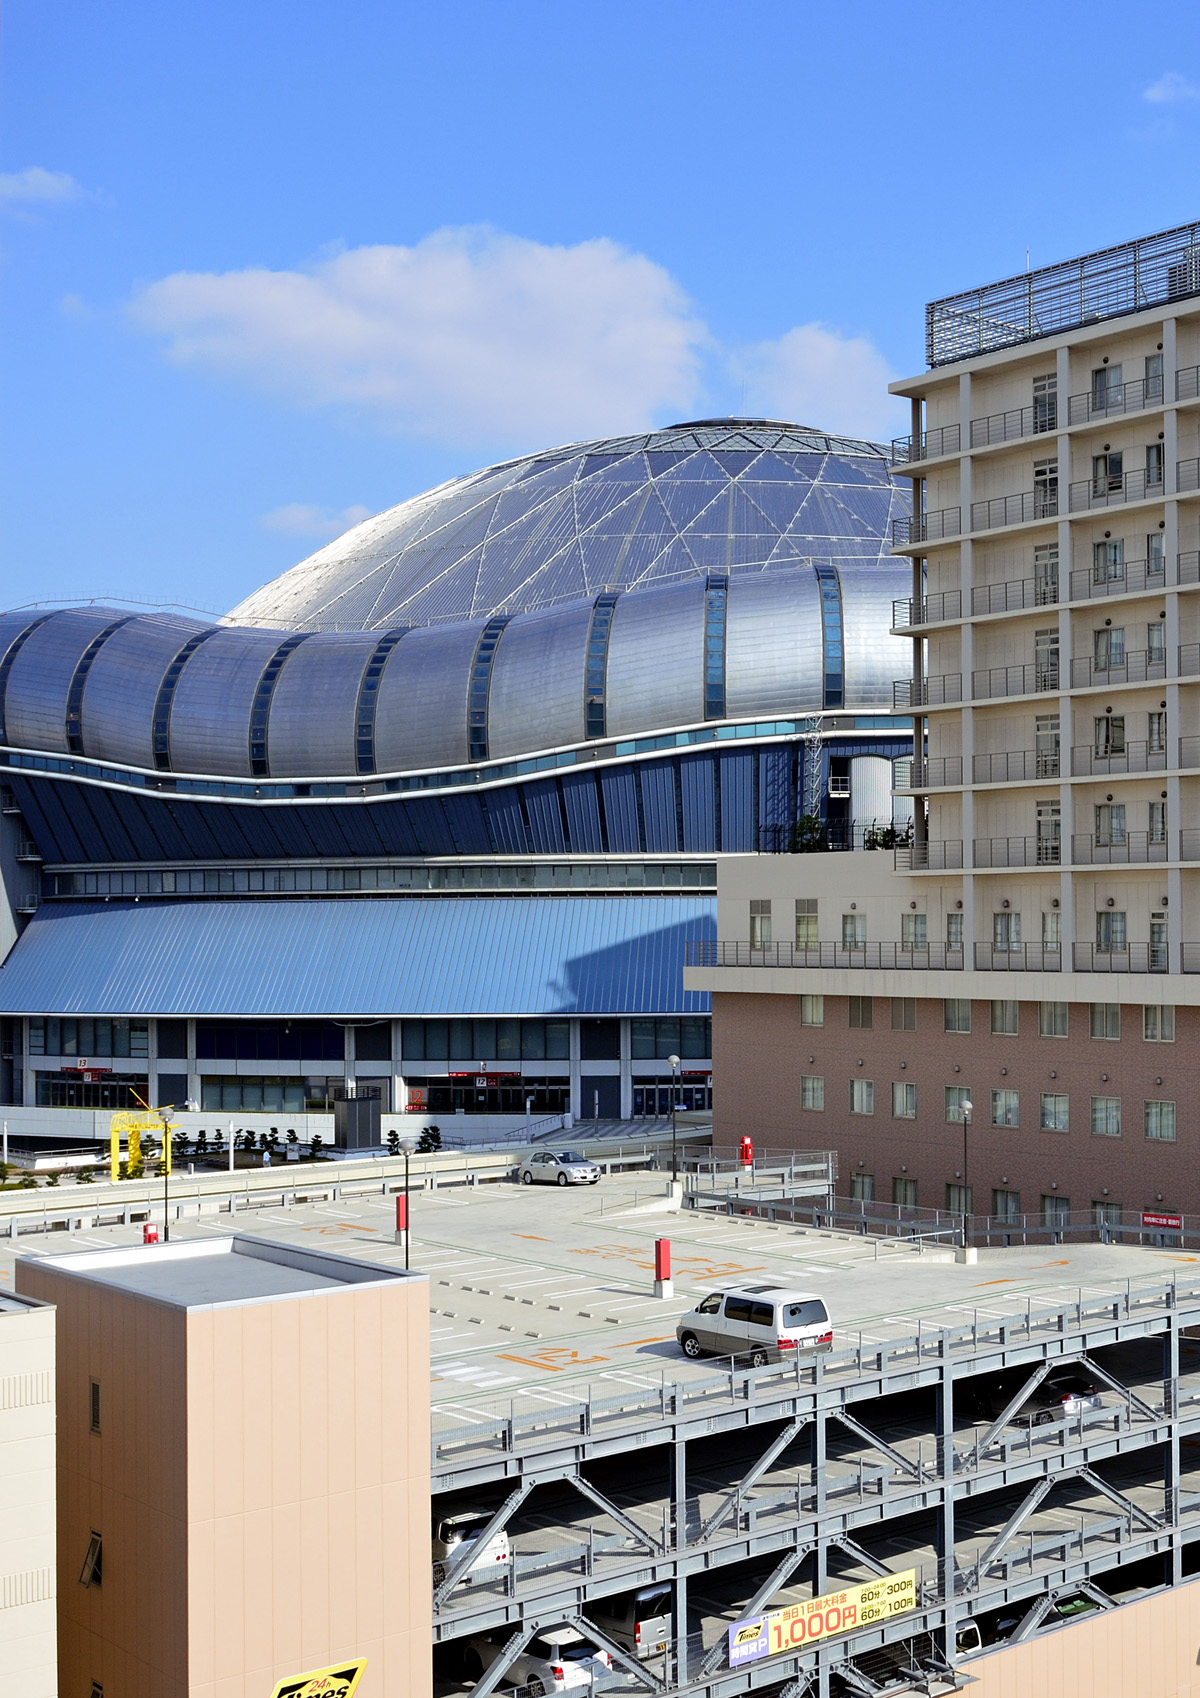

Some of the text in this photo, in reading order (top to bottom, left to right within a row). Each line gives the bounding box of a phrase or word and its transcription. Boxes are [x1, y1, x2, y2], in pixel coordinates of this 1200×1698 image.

[477, 1078, 486, 1086] 12
[409, 1090, 423, 1103] 12
[782, 1592, 848, 1622] 当日1日最大料金
[773, 1604, 857, 1648] 1,000円
[737, 1629, 761, 1642] Times
[731, 1638, 768, 1660] 時間貸P
[308, 1678, 331, 1693] 24h
